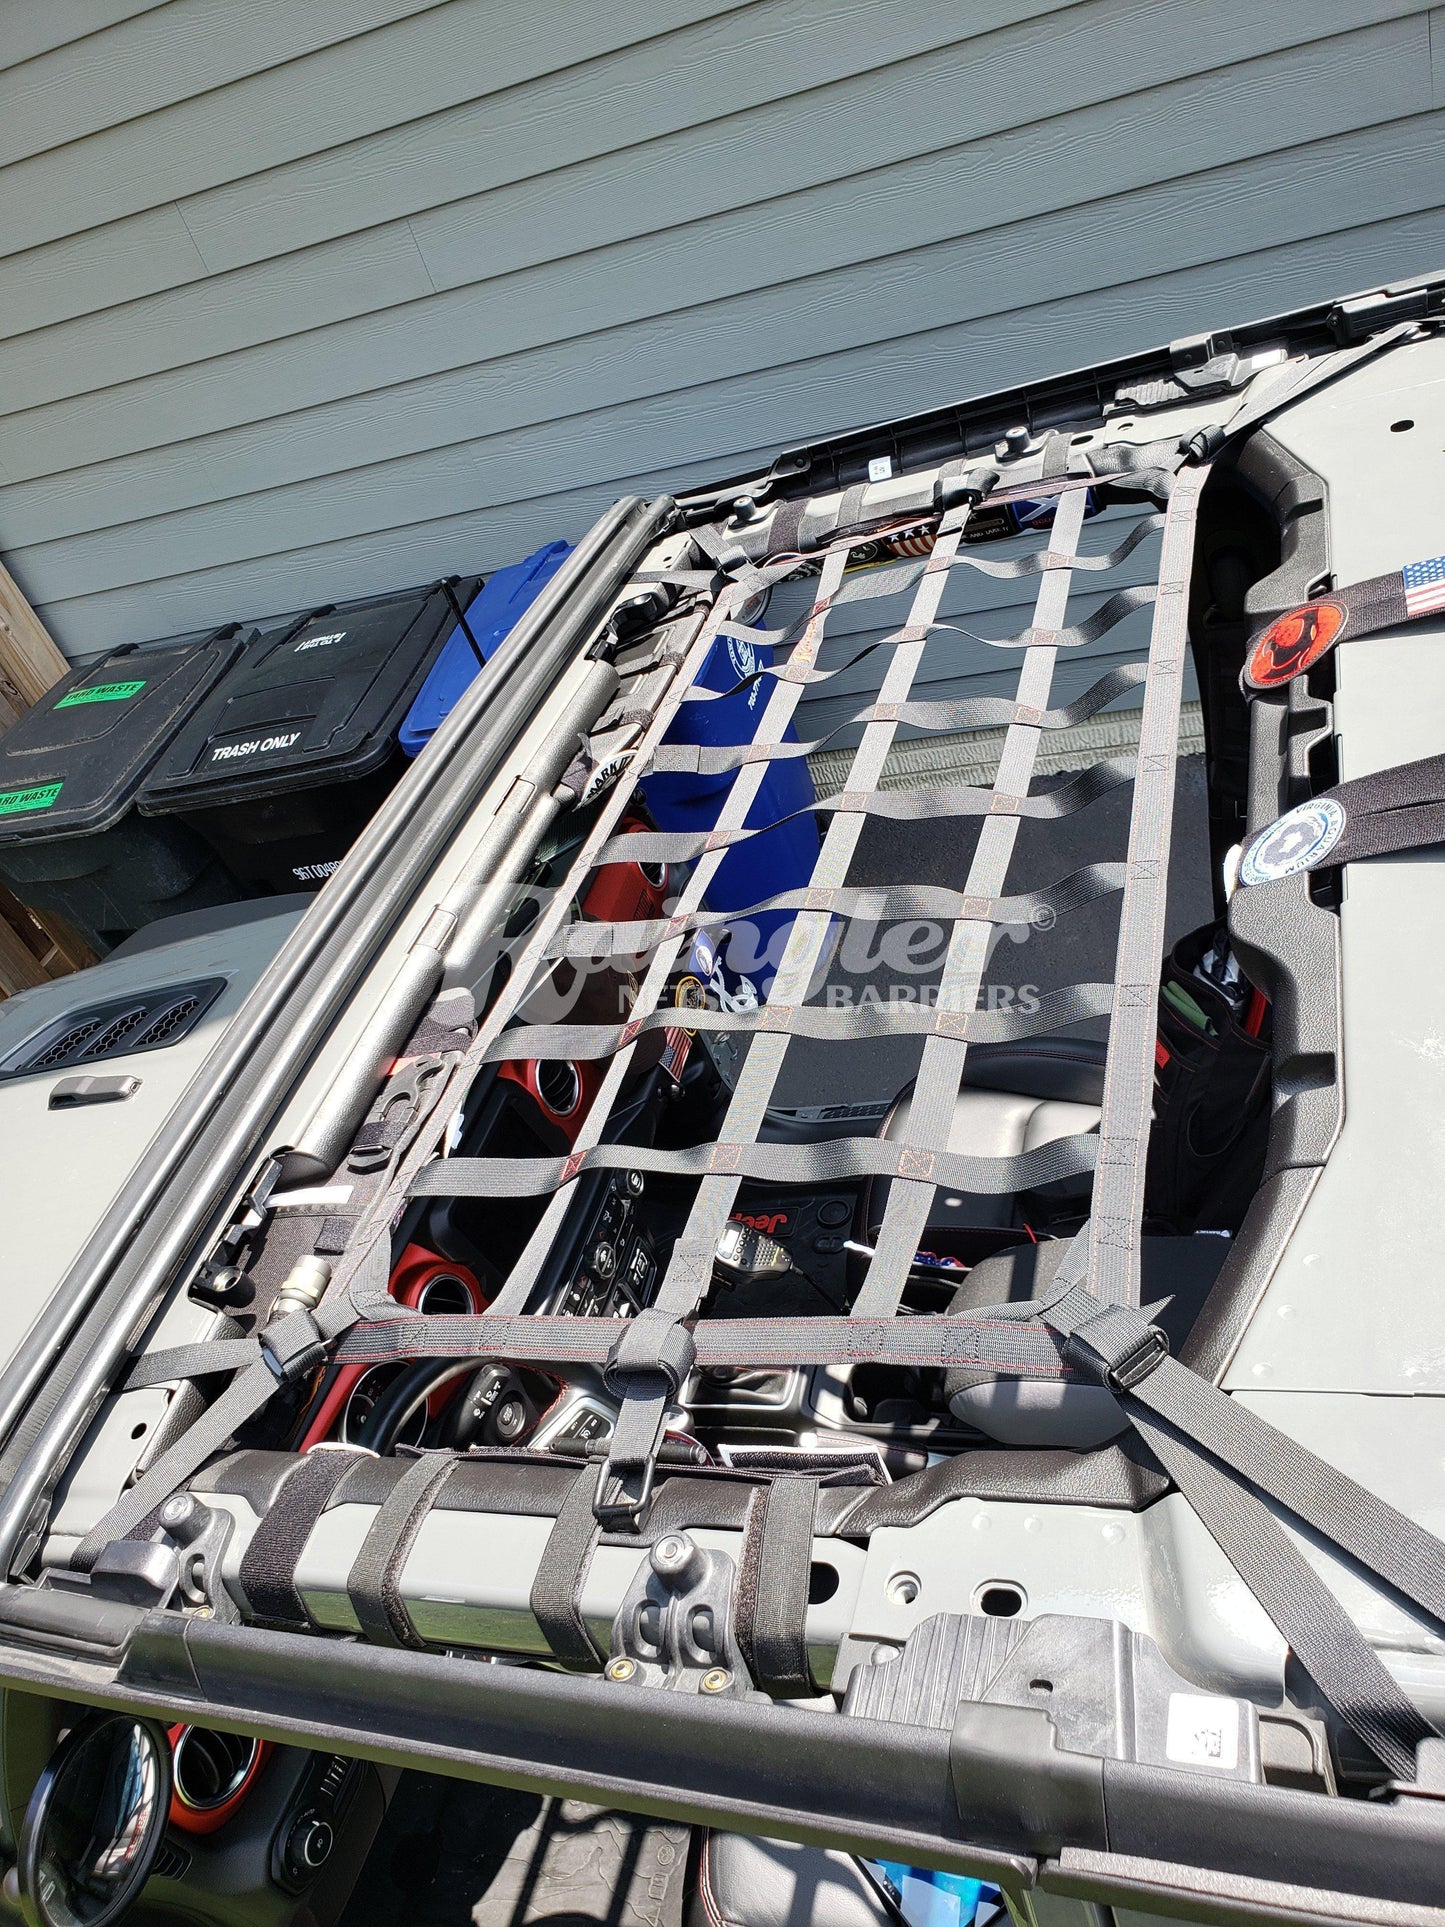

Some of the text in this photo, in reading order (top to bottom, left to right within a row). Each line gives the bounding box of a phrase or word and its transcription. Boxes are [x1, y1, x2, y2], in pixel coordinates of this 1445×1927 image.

[95, 683, 139, 695] WASTE
[211, 732, 302, 761] TRASH ONLY
[19, 787, 60, 802] WASTE
